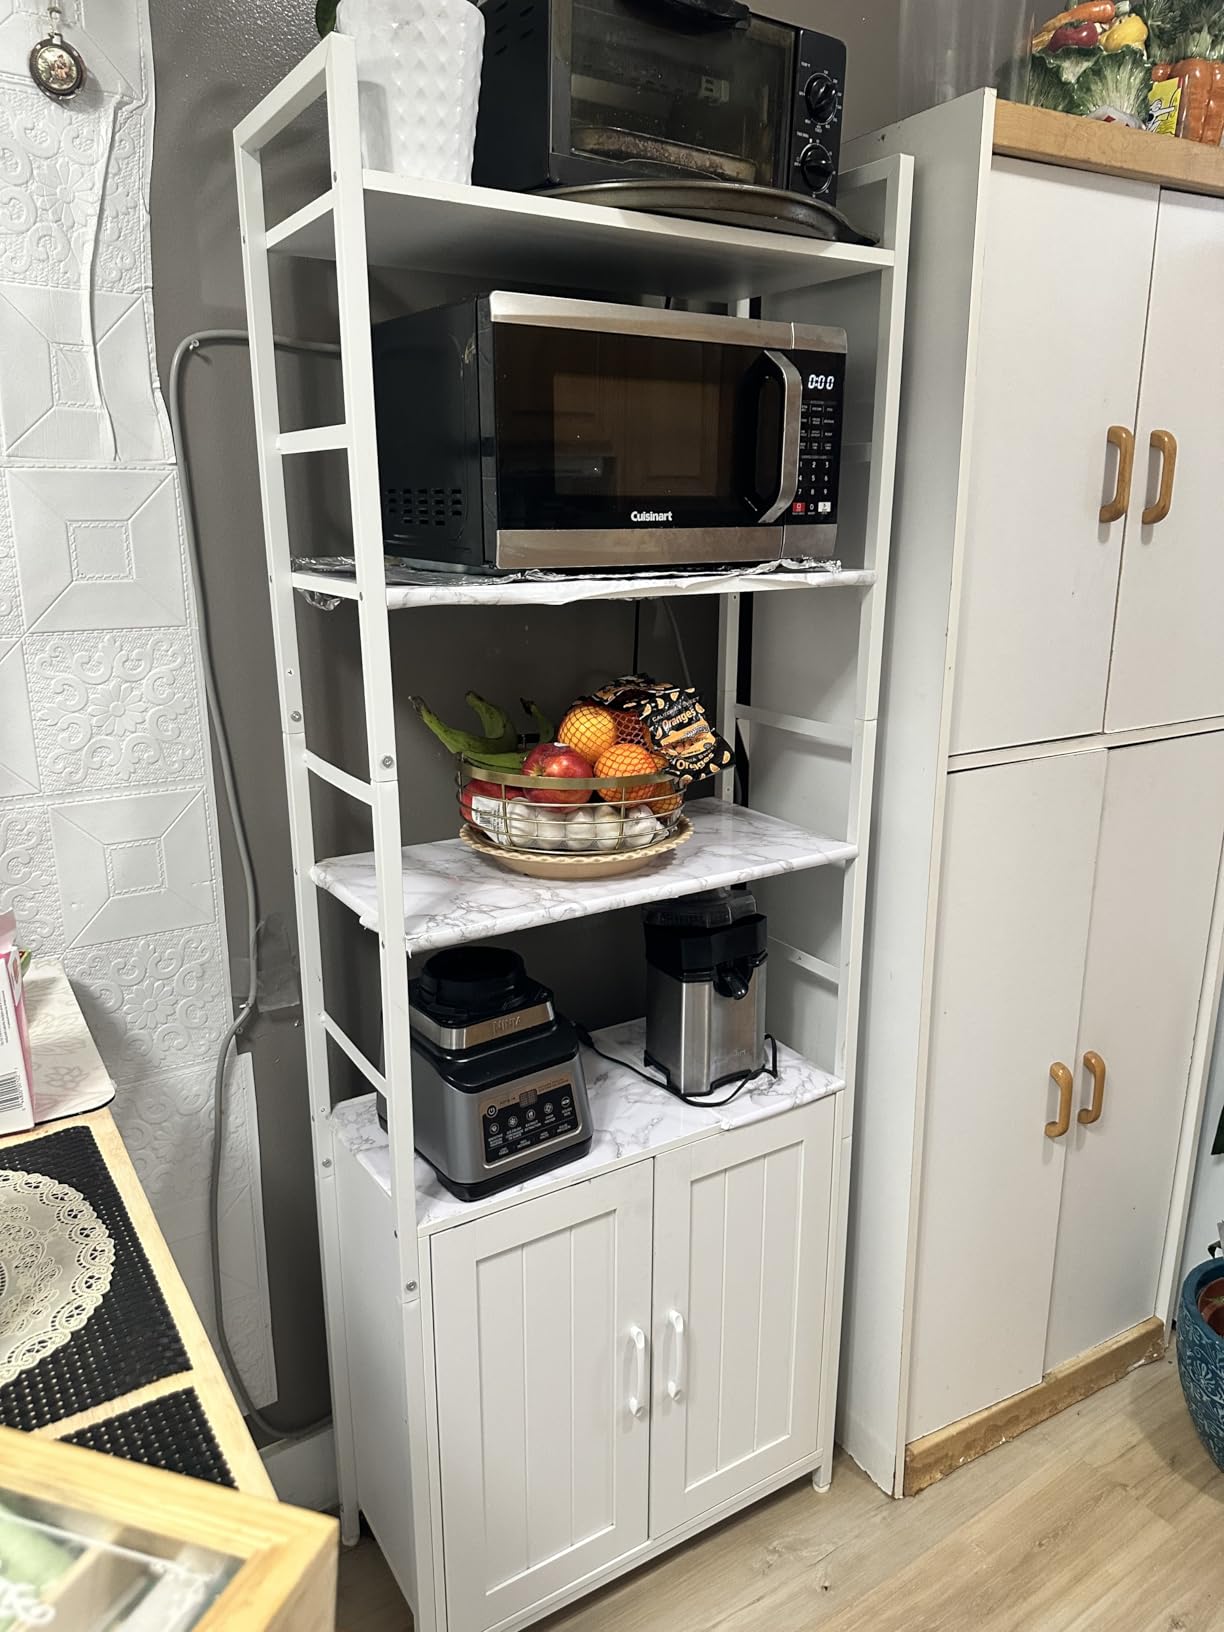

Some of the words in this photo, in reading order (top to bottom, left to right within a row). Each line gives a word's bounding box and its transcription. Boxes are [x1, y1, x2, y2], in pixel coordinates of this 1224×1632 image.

[808, 374, 835, 390] 0:00
[630, 510, 673, 521] Cuisinart
[662, 707, 697, 731] Oranges
